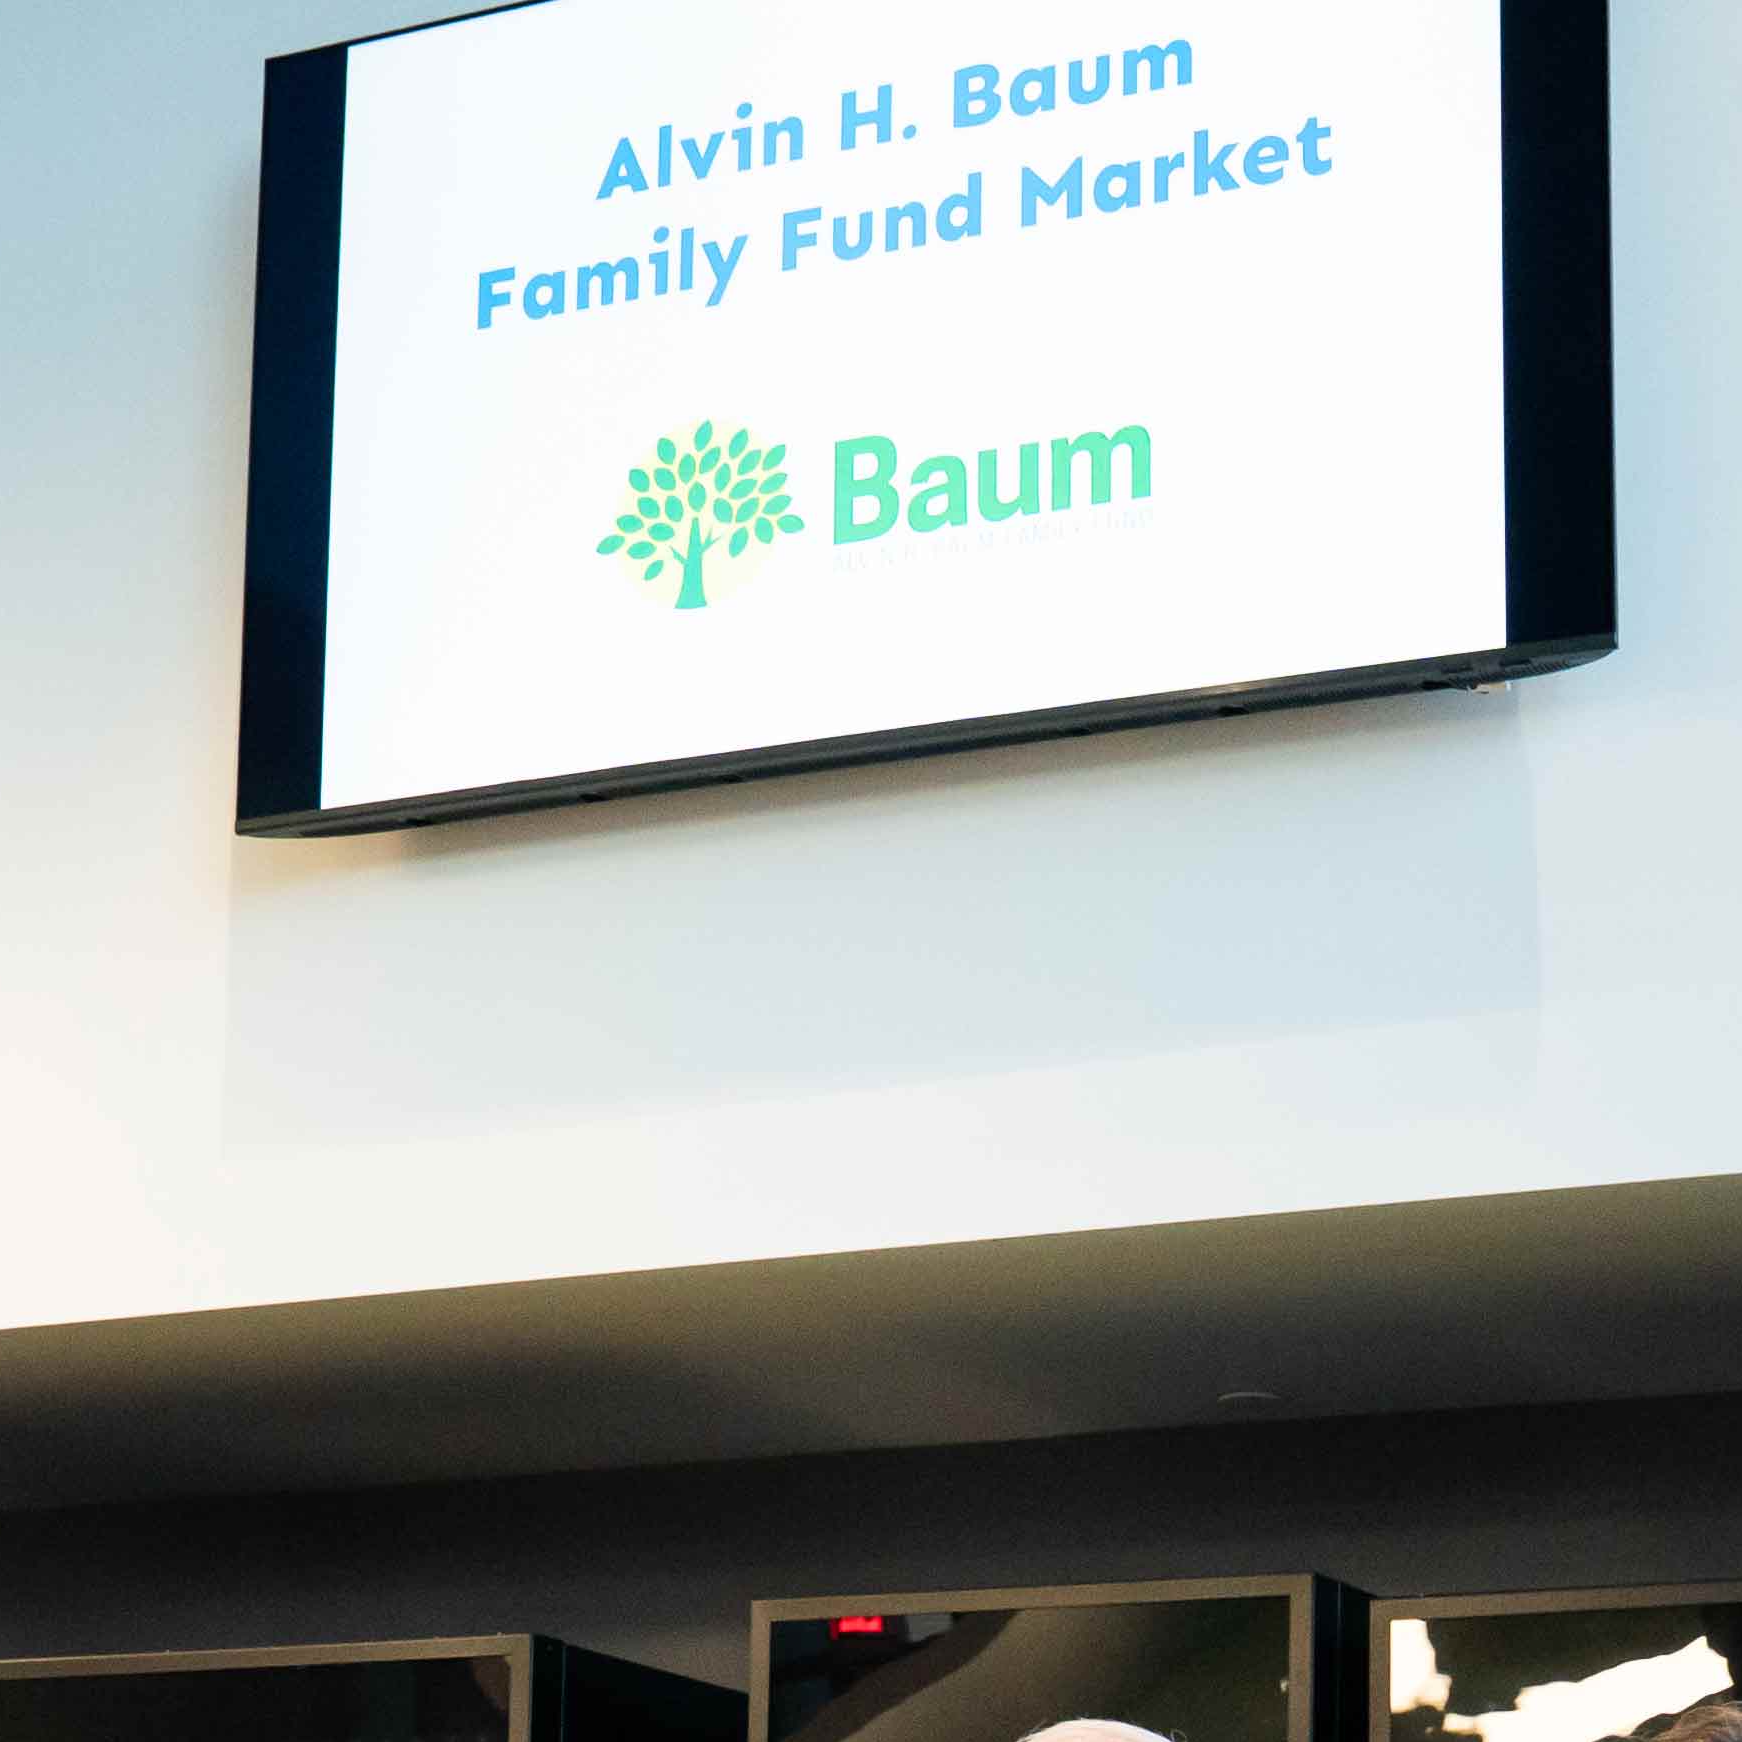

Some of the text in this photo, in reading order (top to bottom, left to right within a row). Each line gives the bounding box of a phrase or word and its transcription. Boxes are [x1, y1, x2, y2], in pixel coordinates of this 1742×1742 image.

[597, 39, 1193, 201] Alvin H. Baum
[476, 116, 1333, 330] Family Fund Market
[833, 424, 1152, 545] Baum
